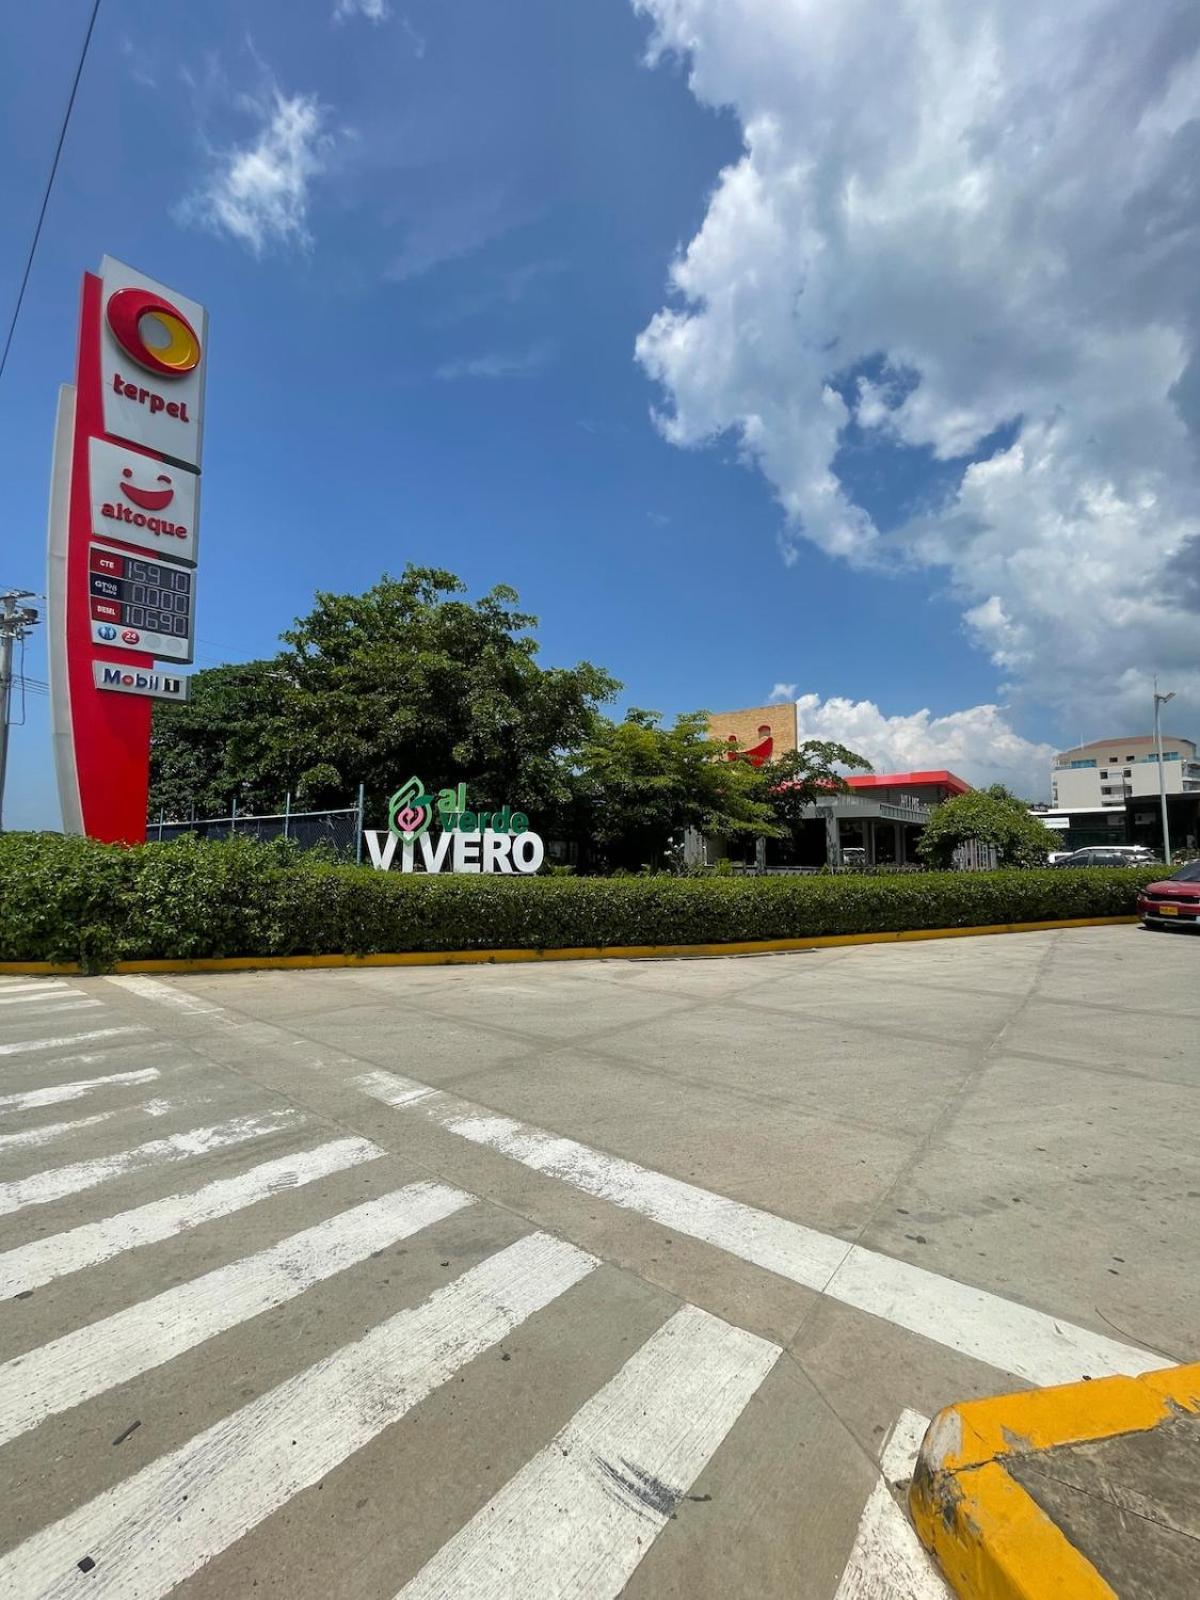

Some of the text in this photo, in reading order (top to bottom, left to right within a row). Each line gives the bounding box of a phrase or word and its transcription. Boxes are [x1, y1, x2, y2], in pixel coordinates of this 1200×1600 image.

[113, 373, 190, 423] terpel
[101, 502, 188, 539] altoque
[100, 560, 115, 569] CTE
[97, 605, 116, 615] DIESEL
[132, 584, 187, 613] 0000
[126, 606, 186, 635] 10690
[103, 668, 159, 690] Mobil
[437, 782, 467, 812] al
[440, 805, 530, 834] verde
[364, 829, 544, 874] VIVERO
